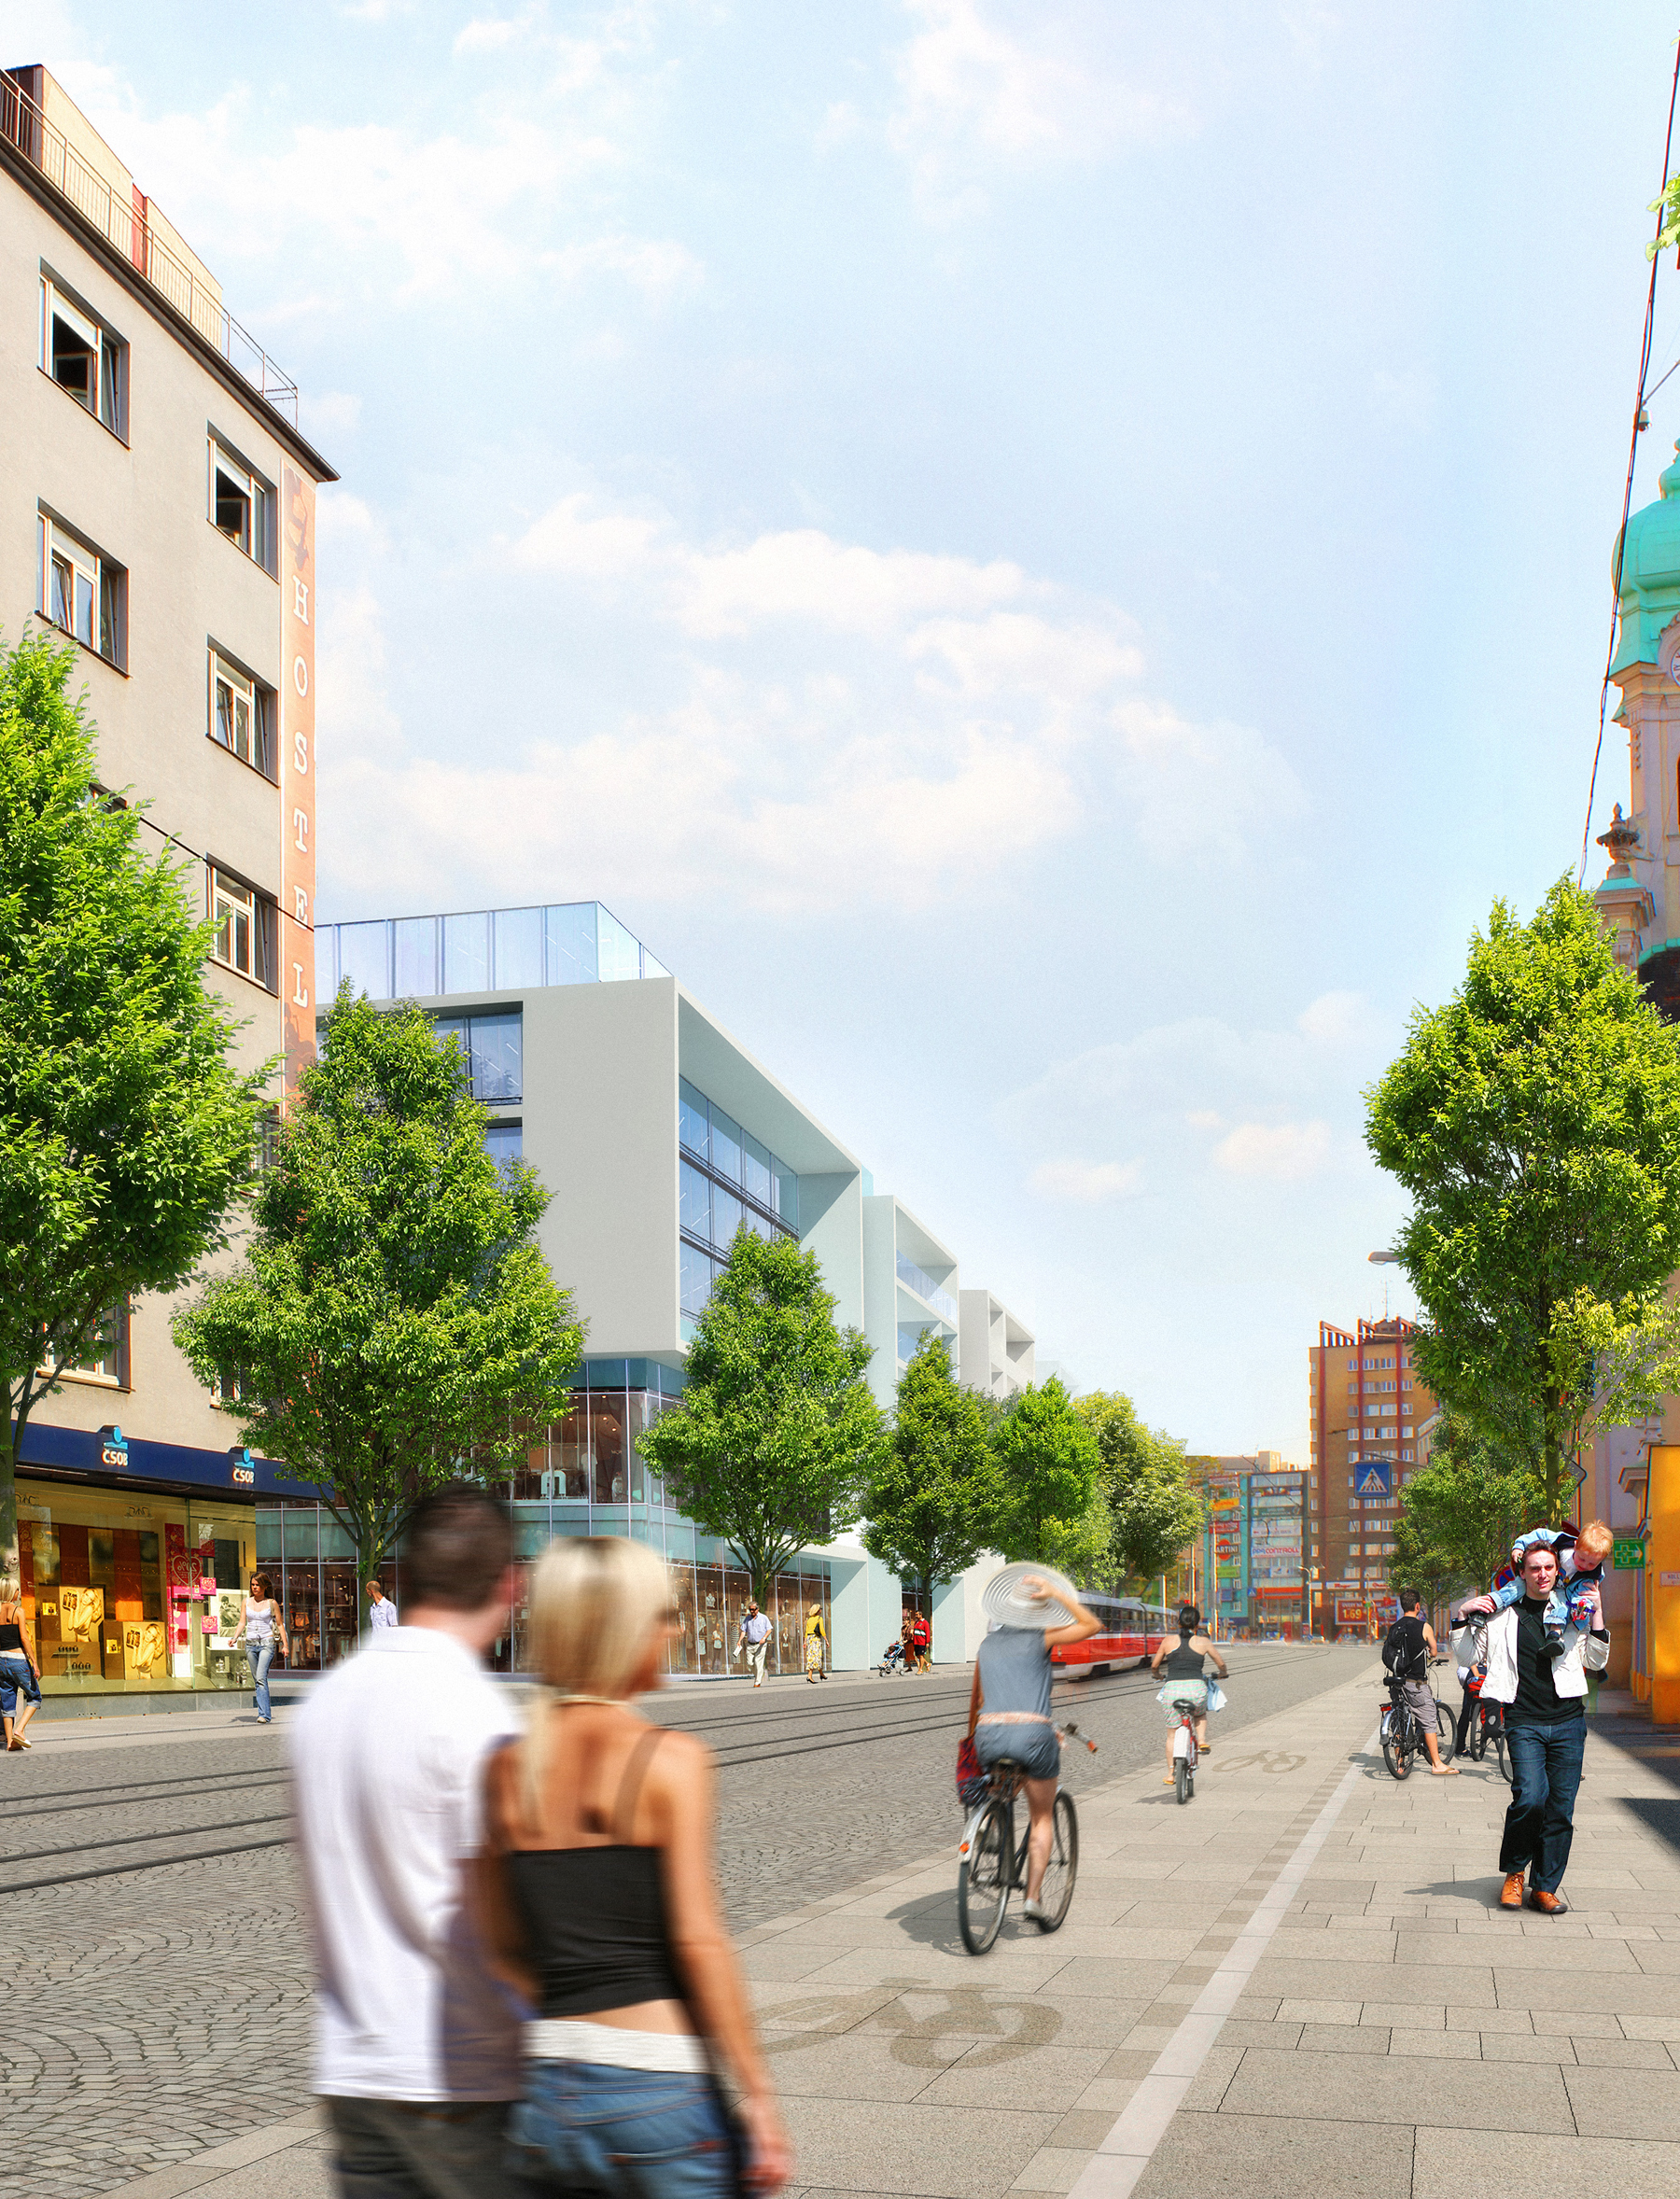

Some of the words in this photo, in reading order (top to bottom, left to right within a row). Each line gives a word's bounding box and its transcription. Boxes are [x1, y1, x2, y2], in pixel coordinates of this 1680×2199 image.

[292, 574, 310, 1008] HOSTEL
[102, 1448, 129, 1466] ČSOB
[232, 1467, 255, 1484] ČSOB
[1215, 1545, 1239, 1554] ARTINI
